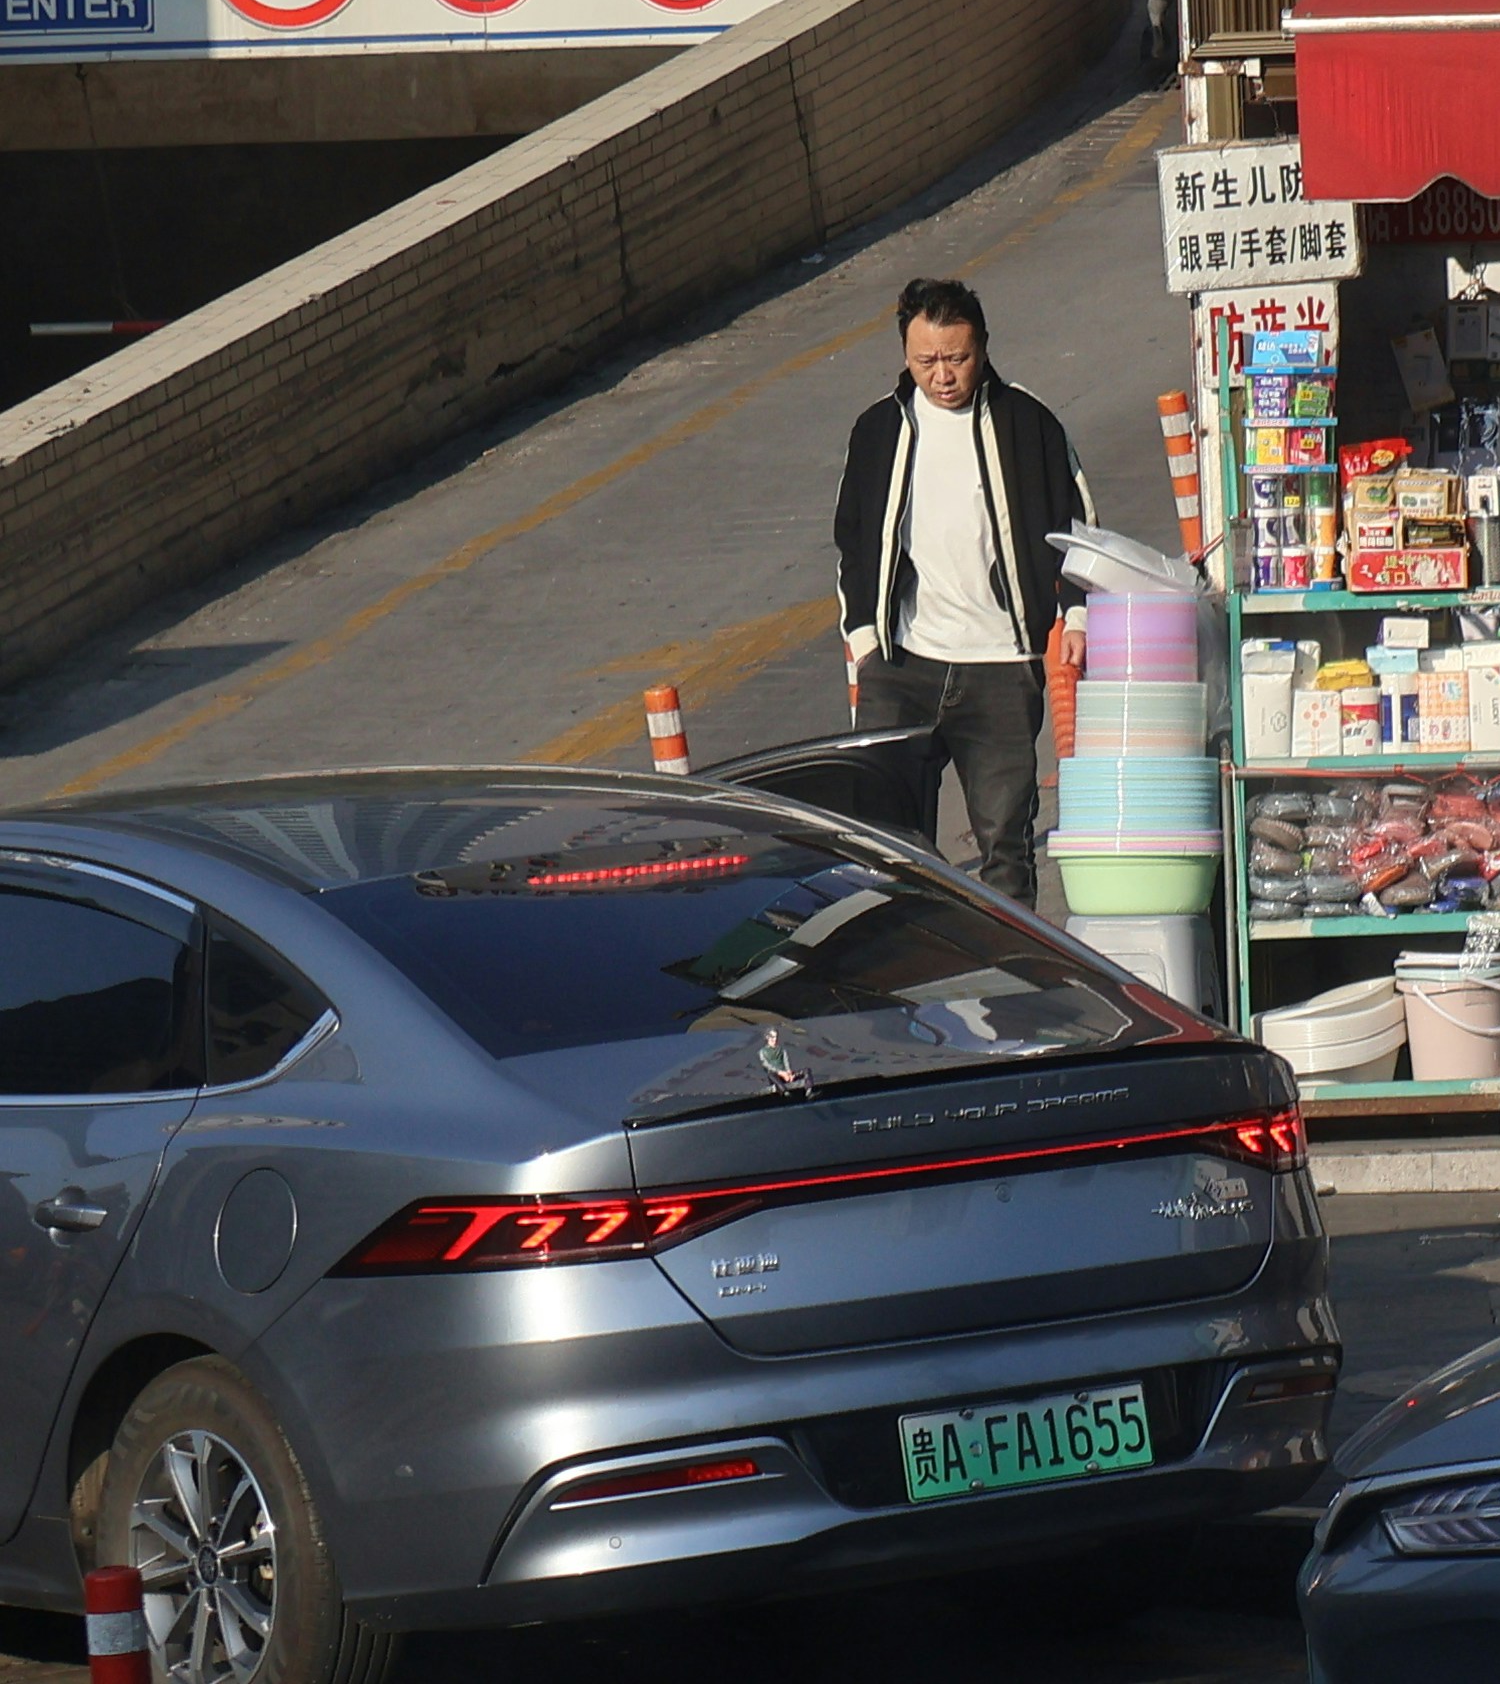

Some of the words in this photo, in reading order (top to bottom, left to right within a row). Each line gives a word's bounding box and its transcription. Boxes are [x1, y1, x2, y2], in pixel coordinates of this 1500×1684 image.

[1178, 220, 1347, 273] 眼罩/手套/脚套
[911, 1422, 967, 1486] 贵A
[984, 1394, 1146, 1476] FA1655
